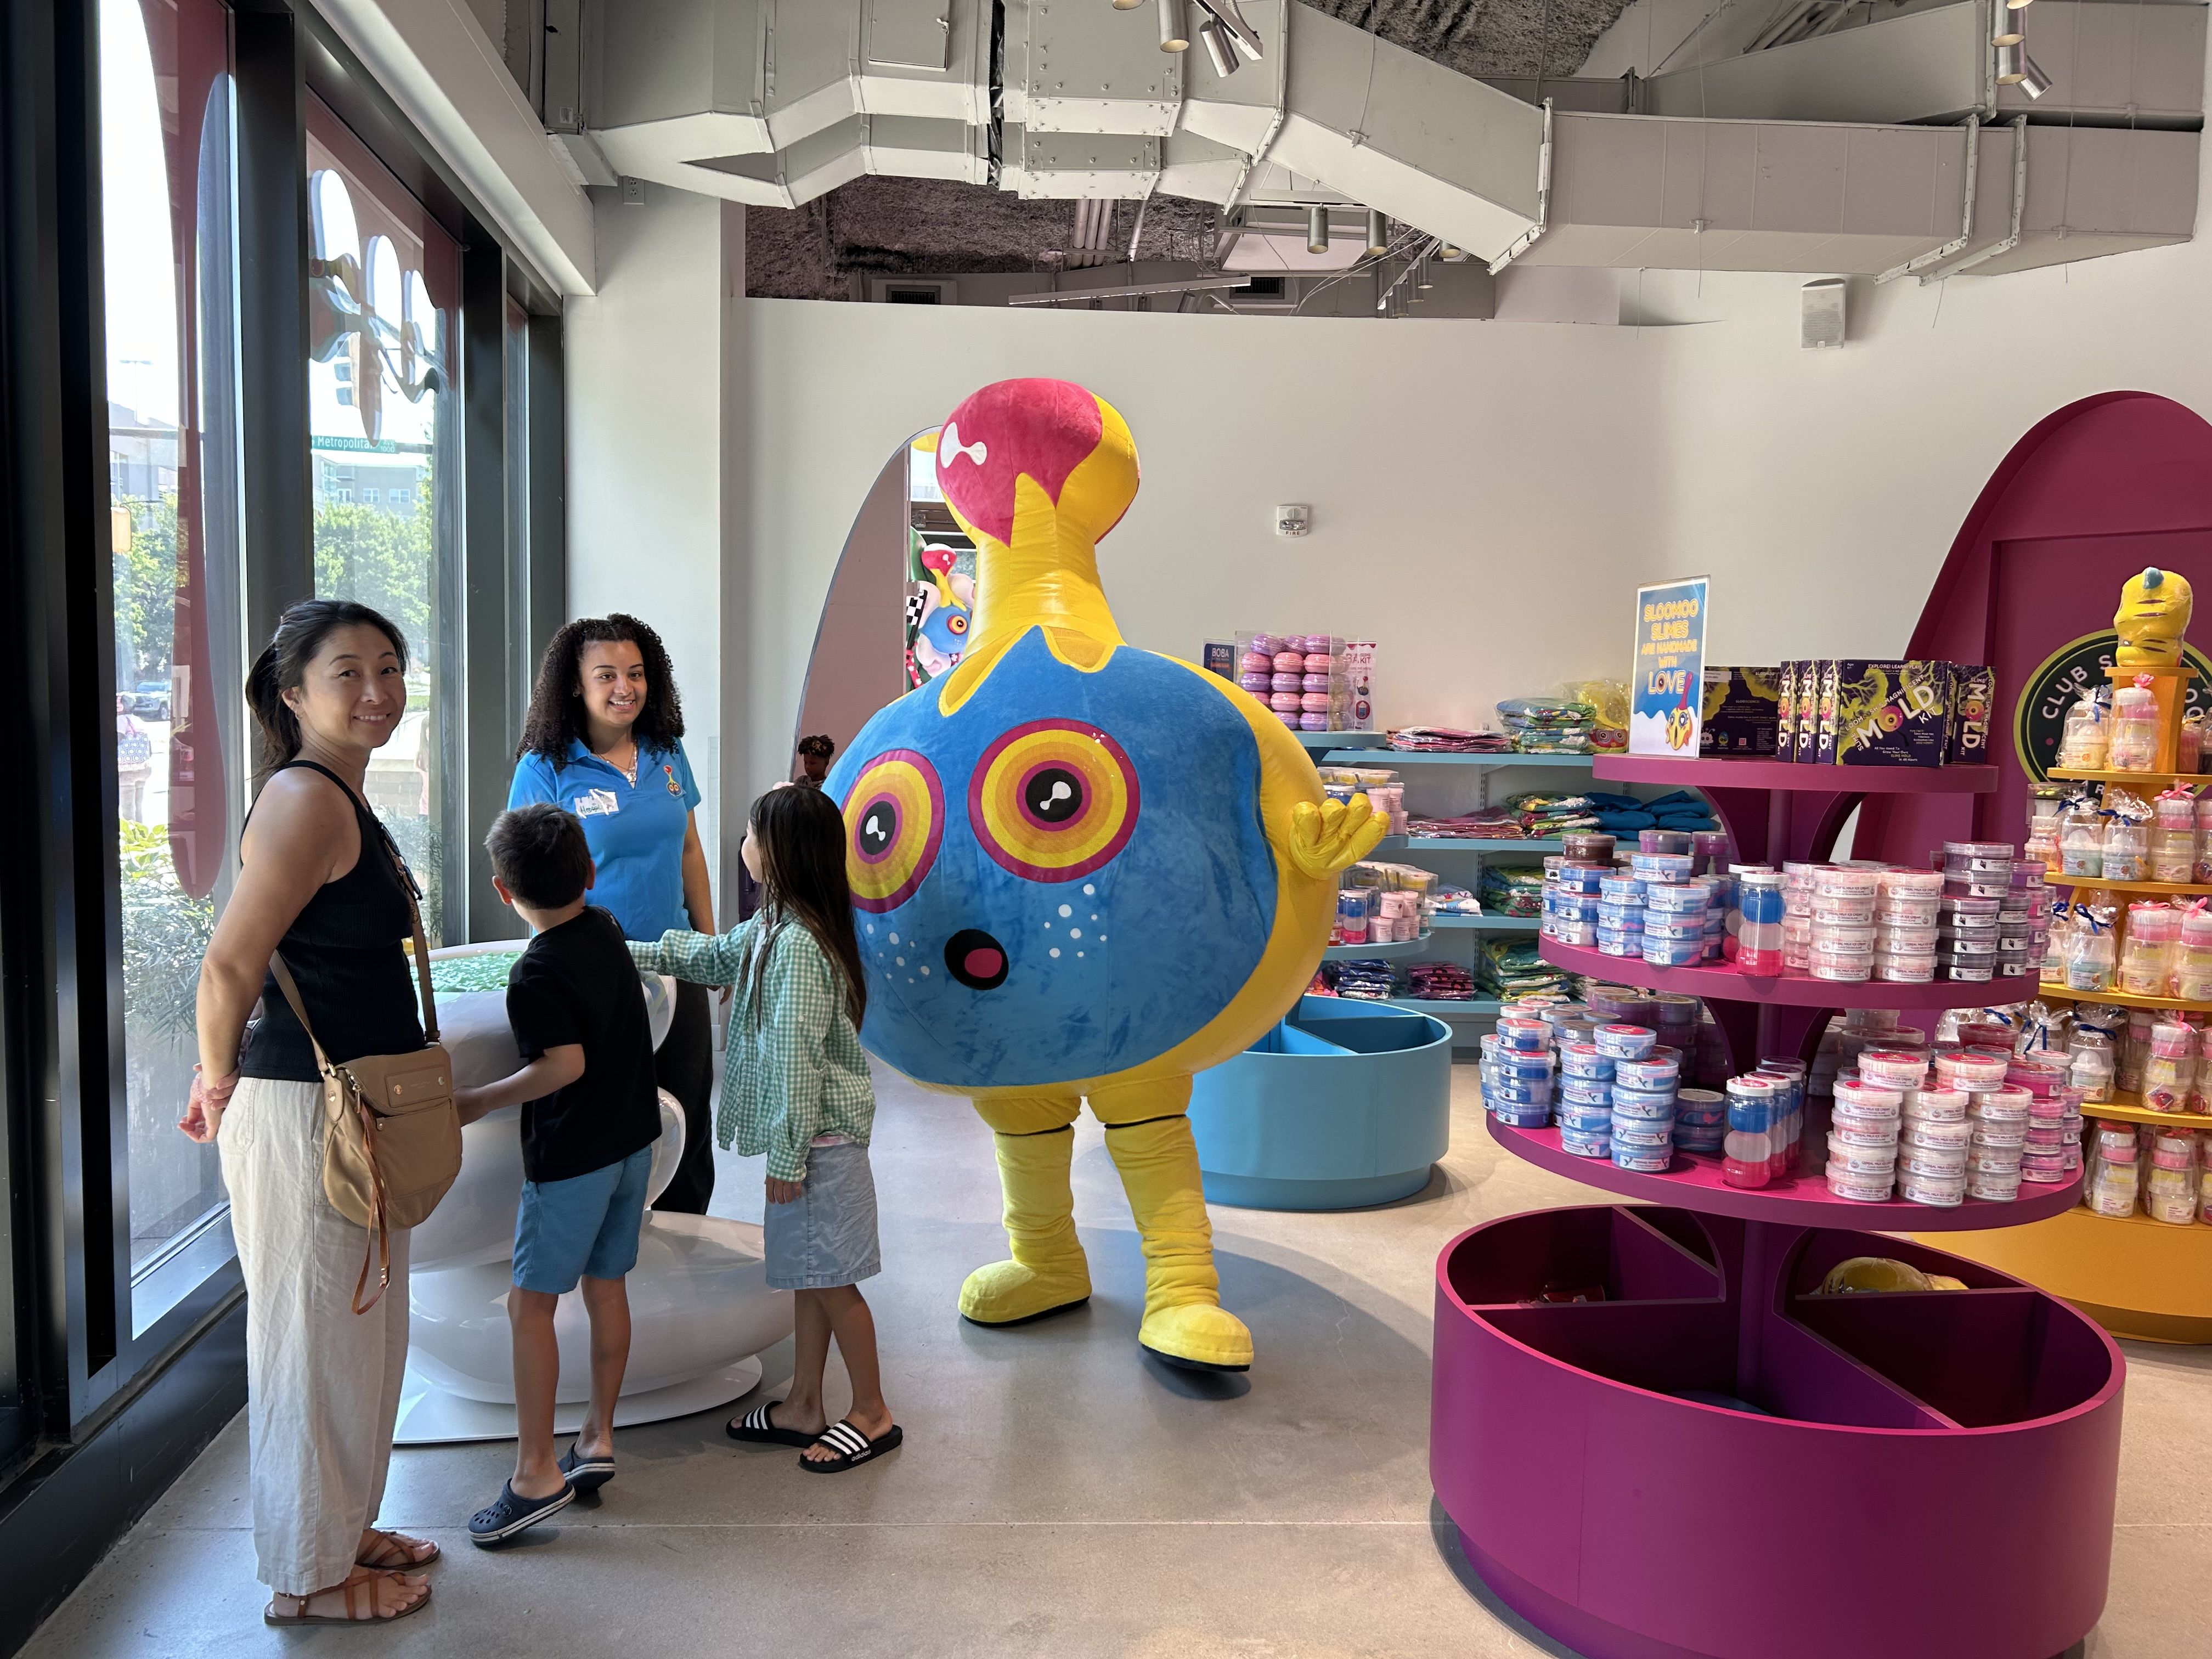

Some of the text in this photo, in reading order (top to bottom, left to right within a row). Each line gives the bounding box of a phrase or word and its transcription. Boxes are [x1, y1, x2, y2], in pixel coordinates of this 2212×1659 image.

[1644, 598, 1699, 622] SLOOMOO
[1651, 620, 1689, 641] SLIMES
[1211, 647, 1229, 657] BOBA
[1641, 639, 1697, 655] ARE HANDMADE
[1658, 656, 1677, 668] WITH
[1647, 669, 1686, 695] LOVE
[1884, 674, 1925, 704] MAGNIFICENT
[2042, 665, 2088, 719] CLUB
[1856, 685, 1934, 748] MOLD
[1918, 706, 1937, 724] KIT
[1962, 684, 1987, 748] MOLD
[1850, 732, 1864, 752] SLIME
[1980, 714, 1989, 750] MAGNIFICENT
[851, 1449, 871, 1462] adidas
